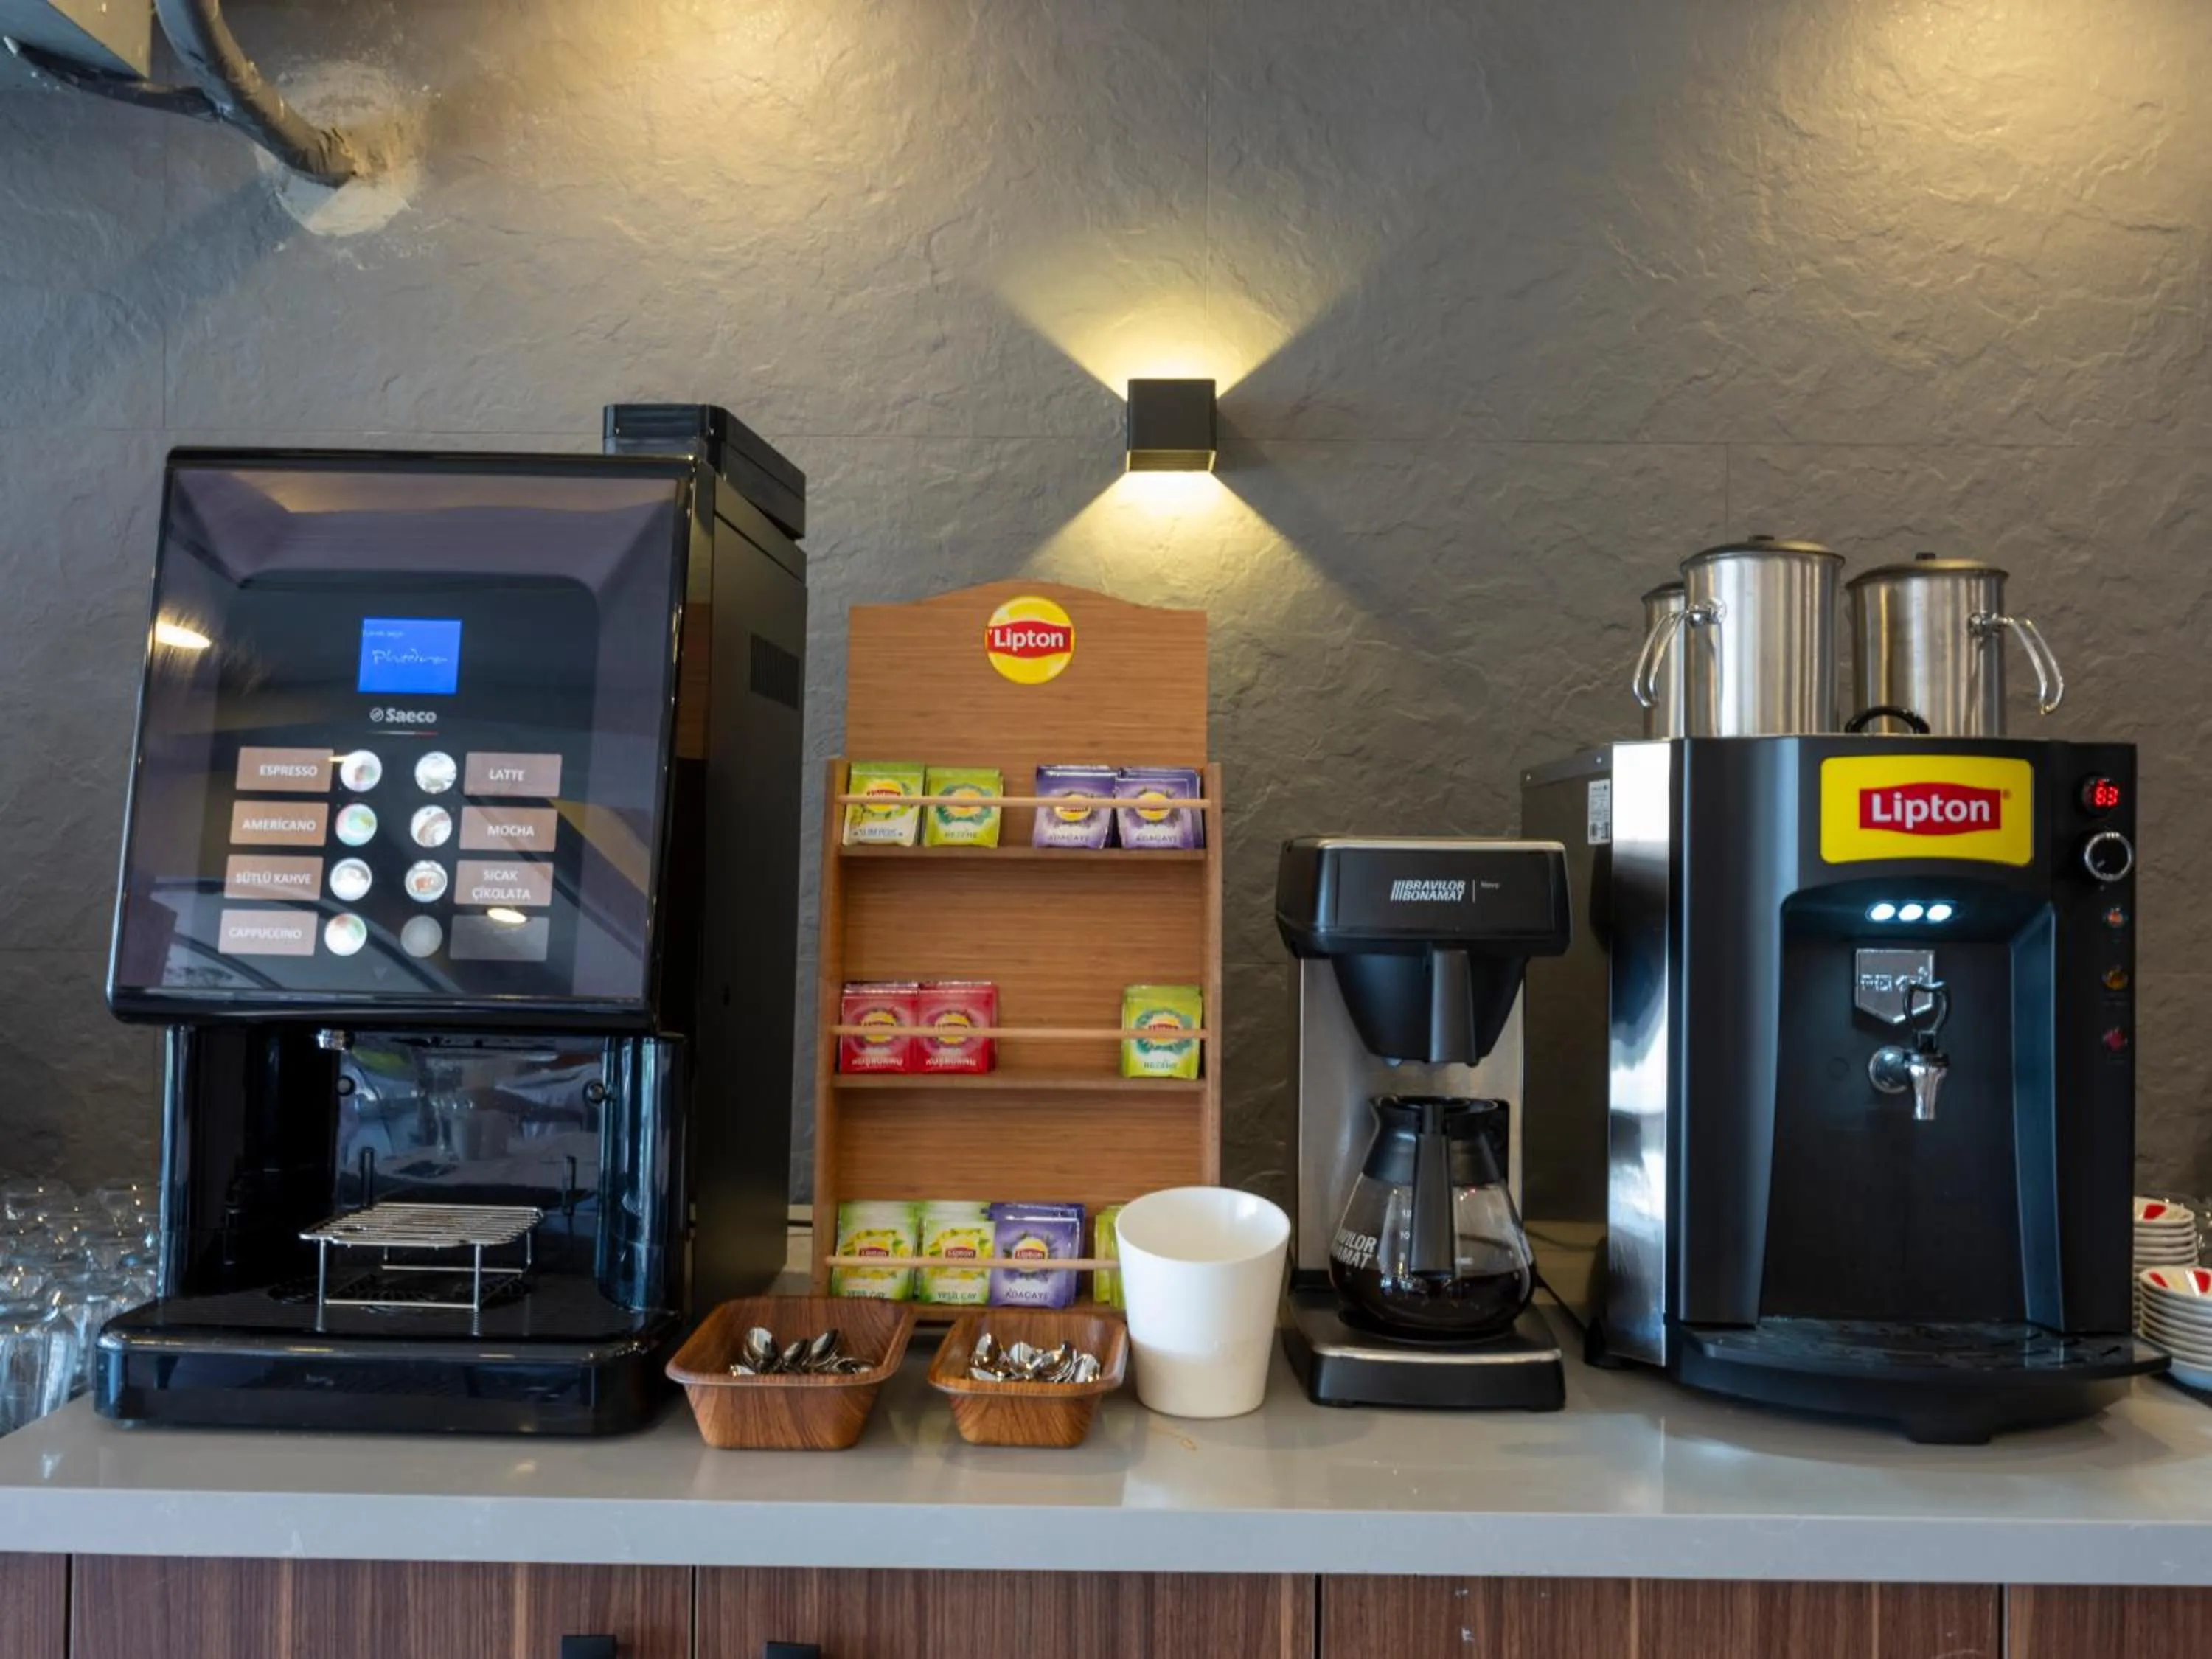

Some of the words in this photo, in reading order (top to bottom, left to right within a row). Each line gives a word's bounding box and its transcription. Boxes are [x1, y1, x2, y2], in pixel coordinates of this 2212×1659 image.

[993, 627, 1064, 652] Lipton
[386, 707, 437, 723] Saeco
[259, 765, 319, 777] ESPRESSO
[489, 768, 526, 782] LATTE
[1871, 791, 1990, 830] Lipton
[487, 824, 535, 837] MOCHA
[274, 872, 312, 885] KAHVE
[1404, 880, 1466, 891] BRAVILOR
[1402, 891, 1463, 902] BONAMAT
